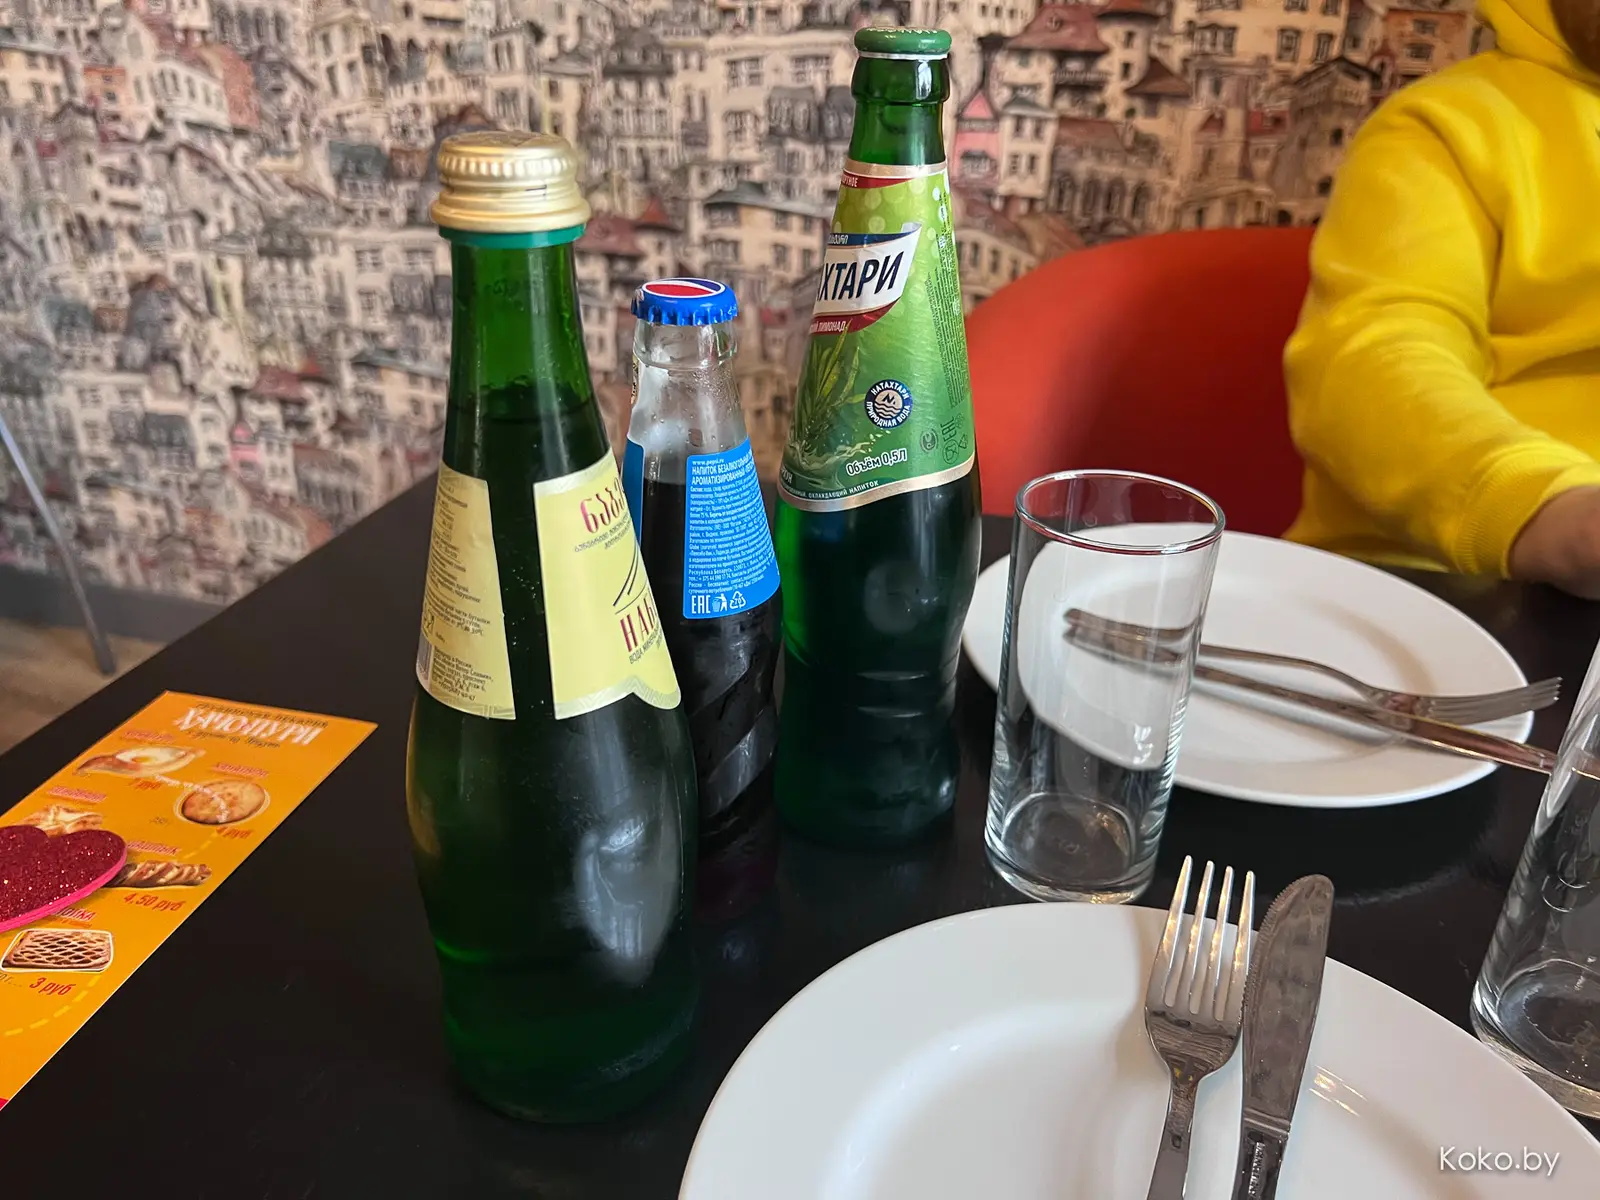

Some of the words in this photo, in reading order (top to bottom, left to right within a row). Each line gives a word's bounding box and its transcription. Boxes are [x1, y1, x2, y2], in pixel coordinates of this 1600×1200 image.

[870, 381, 910, 400] НАТАХТАРИ
[866, 401, 897, 427] ПРИРОДНАЯ
[896, 404, 911, 423] ВОДА
[692, 465, 718, 476] НАПИТОК
[846, 458, 881, 477] Объём
[849, 480, 879, 494] НАПИТОК
[123, 892, 159, 907] 4,50
[152, 899, 187, 912] руб
[29, 976, 48, 989] 3
[37, 981, 77, 996] руб
